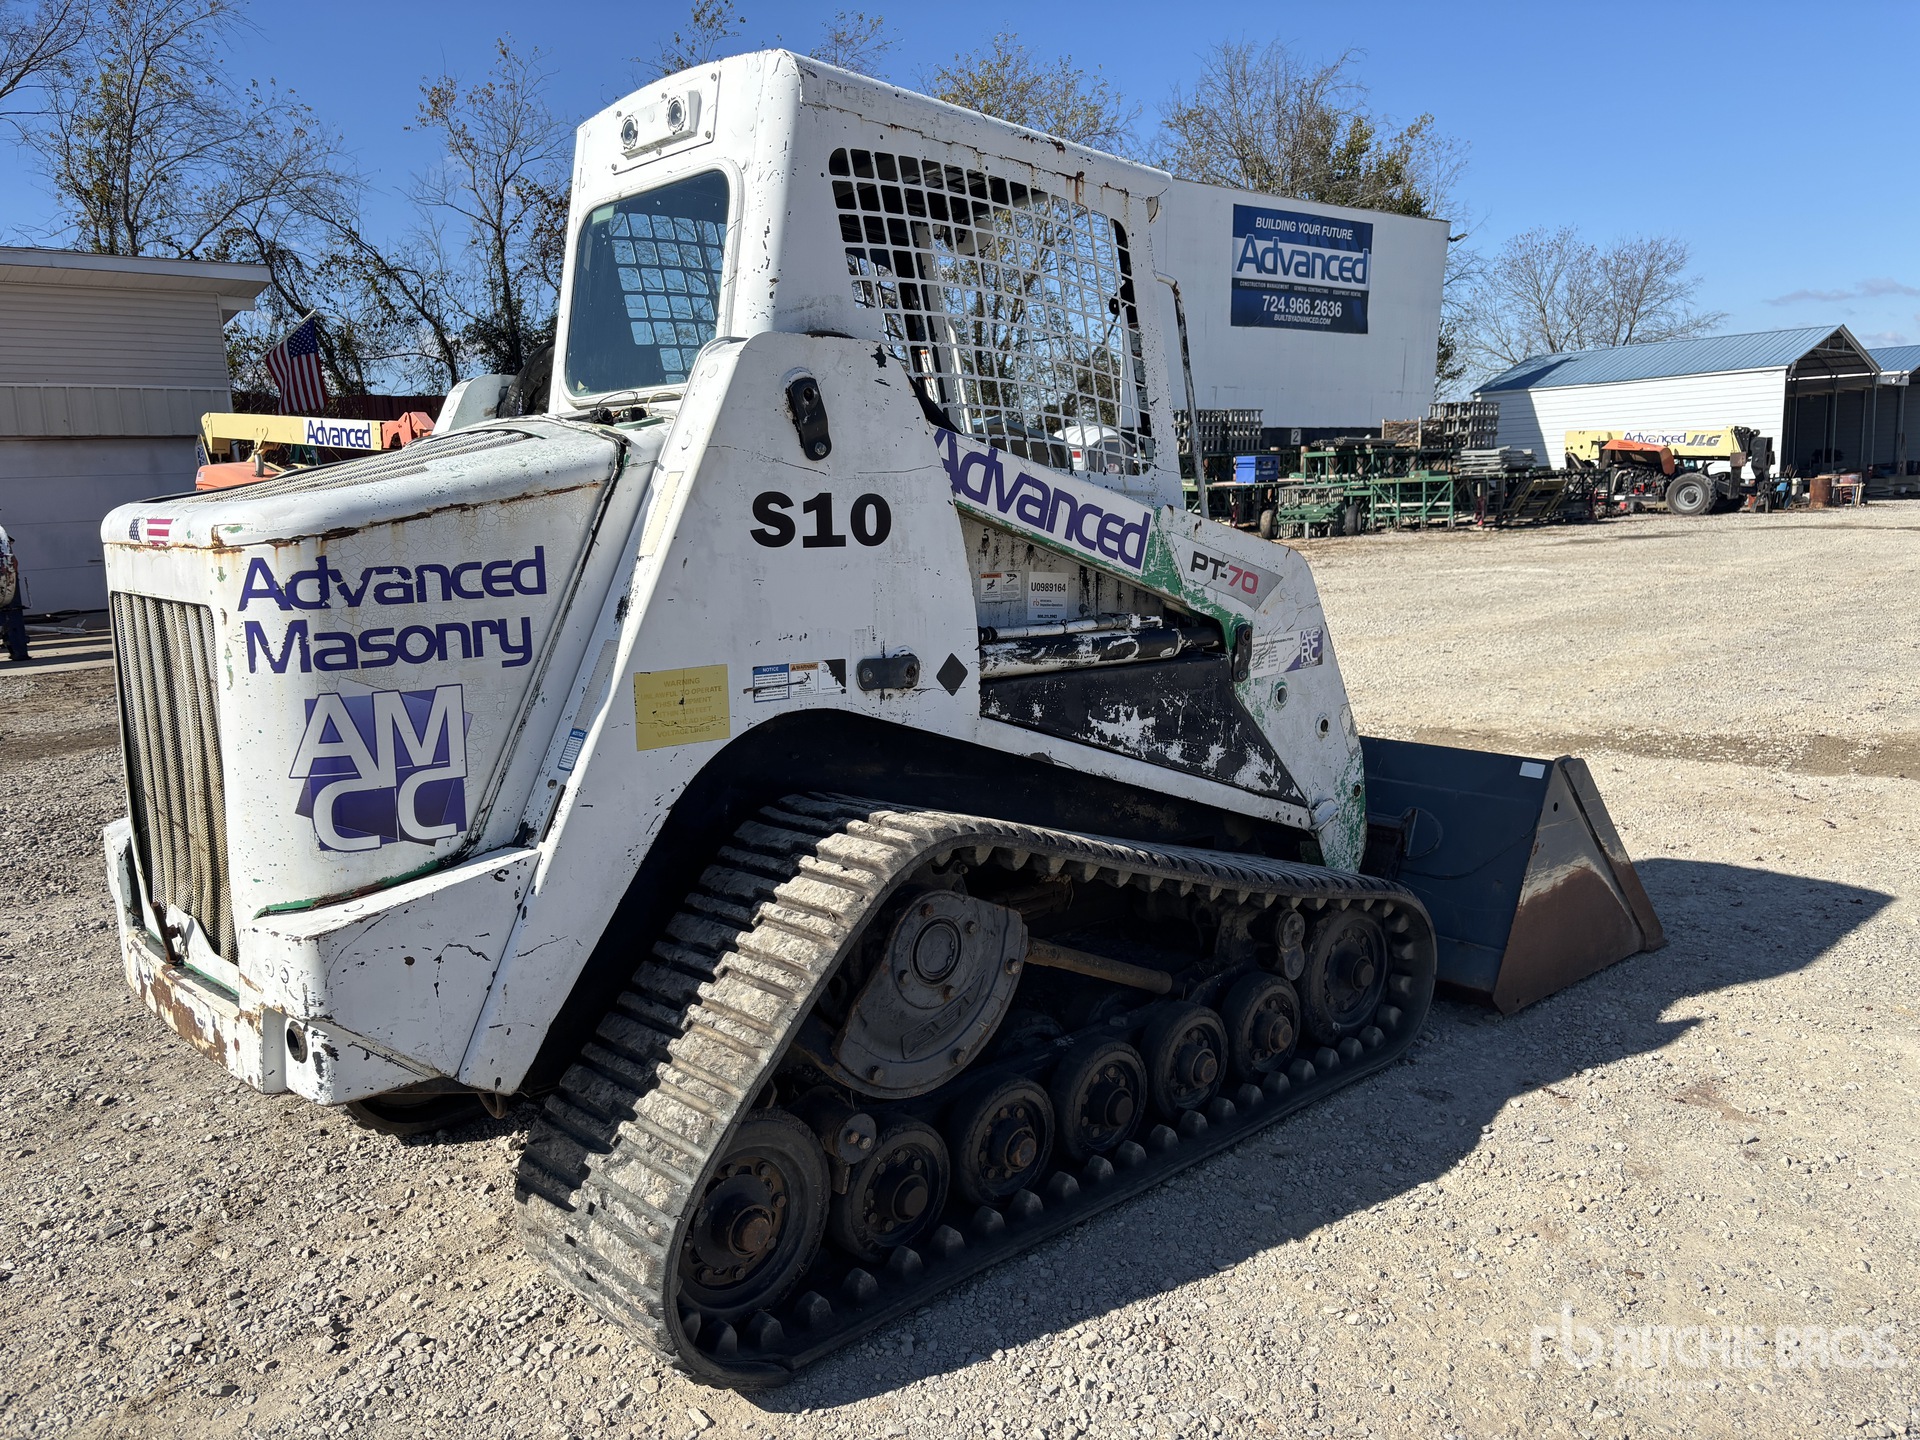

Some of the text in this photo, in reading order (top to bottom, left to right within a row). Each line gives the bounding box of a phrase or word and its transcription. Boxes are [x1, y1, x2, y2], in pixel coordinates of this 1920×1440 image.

[1255, 216, 1354, 241] BUILDING YOUR FUTURE
[1236, 233, 1369, 285] Advanced
[1262, 294, 1343, 318] 724.966.2636
[1273, 313, 1332, 326] BUILTBYADVANCED.COM
[306, 419, 372, 449] Advanced
[1292, 430, 1299, 443] 2
[1623, 431, 1722, 447] Advanced JLG
[932, 427, 1152, 569] Advanced
[750, 491, 892, 549] S10
[237, 545, 548, 612] Advanced
[1190, 550, 1260, 595] PT-70
[1030, 581, 1067, 593] U0989164
[243, 616, 532, 674] Masonry
[640, 690, 679, 700] UNLAWFUL
[691, 685, 723, 695] OPERATE
[664, 677, 701, 688] WARNING
[655, 695, 713, 709] THIS EUIPMENT
[657, 725, 711, 738] VOLTAGE LINES
